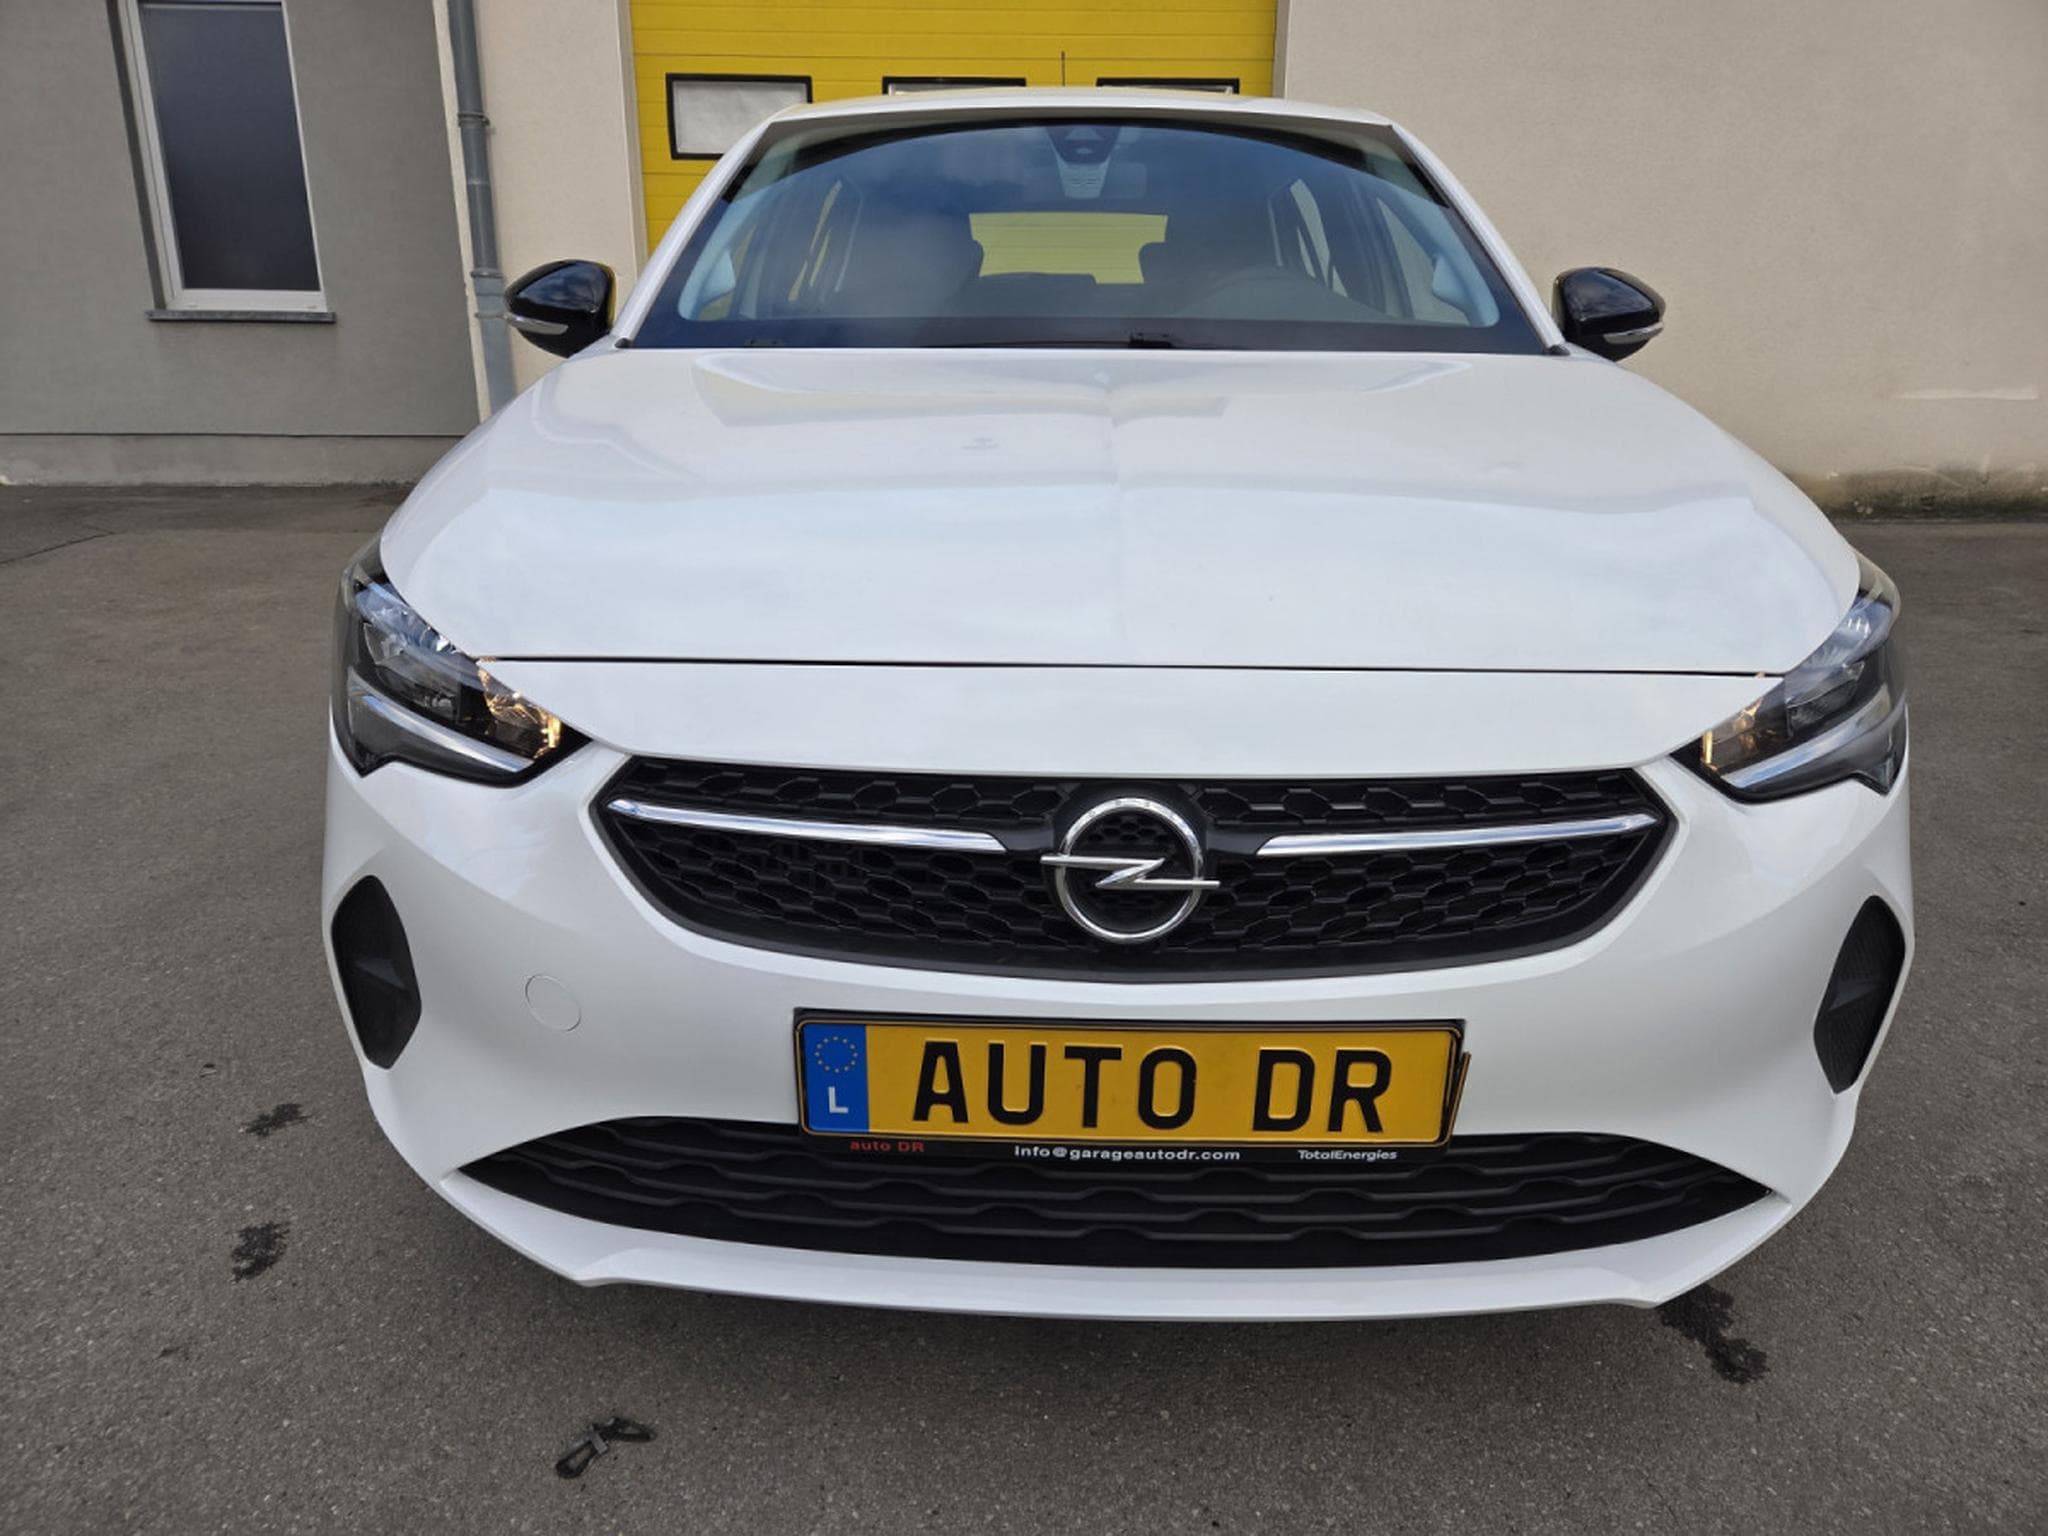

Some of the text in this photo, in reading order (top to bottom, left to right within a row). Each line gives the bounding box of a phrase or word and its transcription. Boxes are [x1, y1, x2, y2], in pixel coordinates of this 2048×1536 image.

[911, 1040, 1393, 1133] AUTO DR
[828, 1086, 849, 1114] L
[849, 1140, 925, 1153] auto DR
[1297, 1149, 1398, 1161] TotalEnergies
